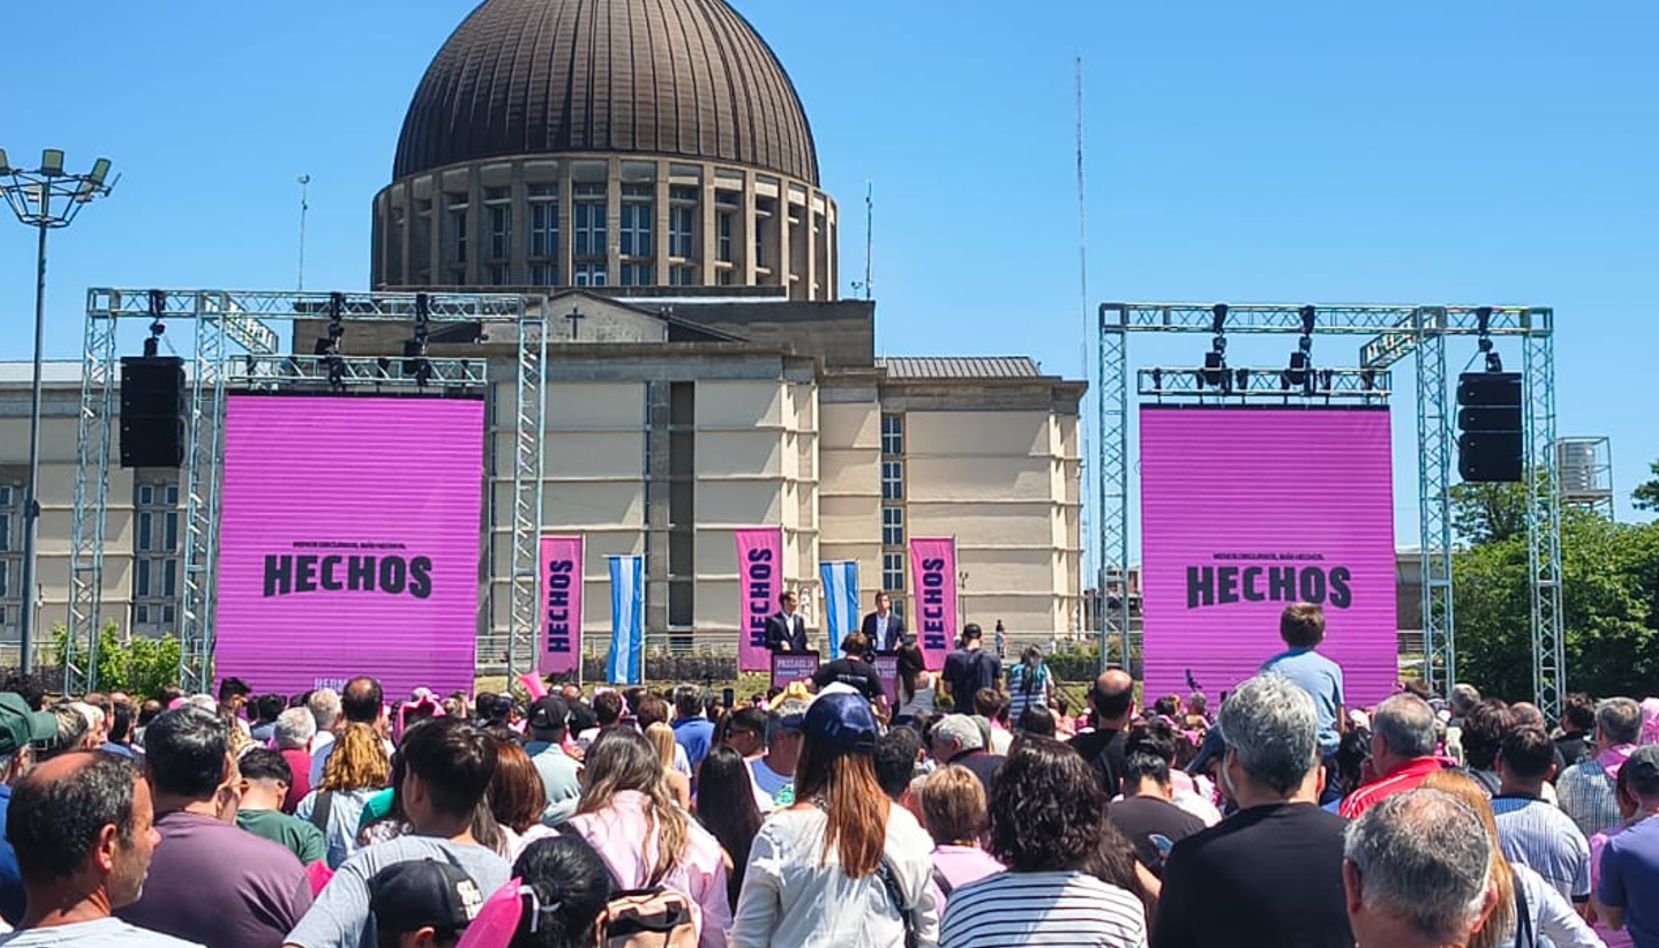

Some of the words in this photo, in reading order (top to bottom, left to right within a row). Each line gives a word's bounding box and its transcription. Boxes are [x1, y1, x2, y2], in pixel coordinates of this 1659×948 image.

[264, 554, 433, 599] HECHOS
[548, 560, 573, 652] HECHOS
[749, 548, 772, 647] HECHOS
[922, 558, 946, 650] HECHOS
[1187, 566, 1352, 609] HECHOS
